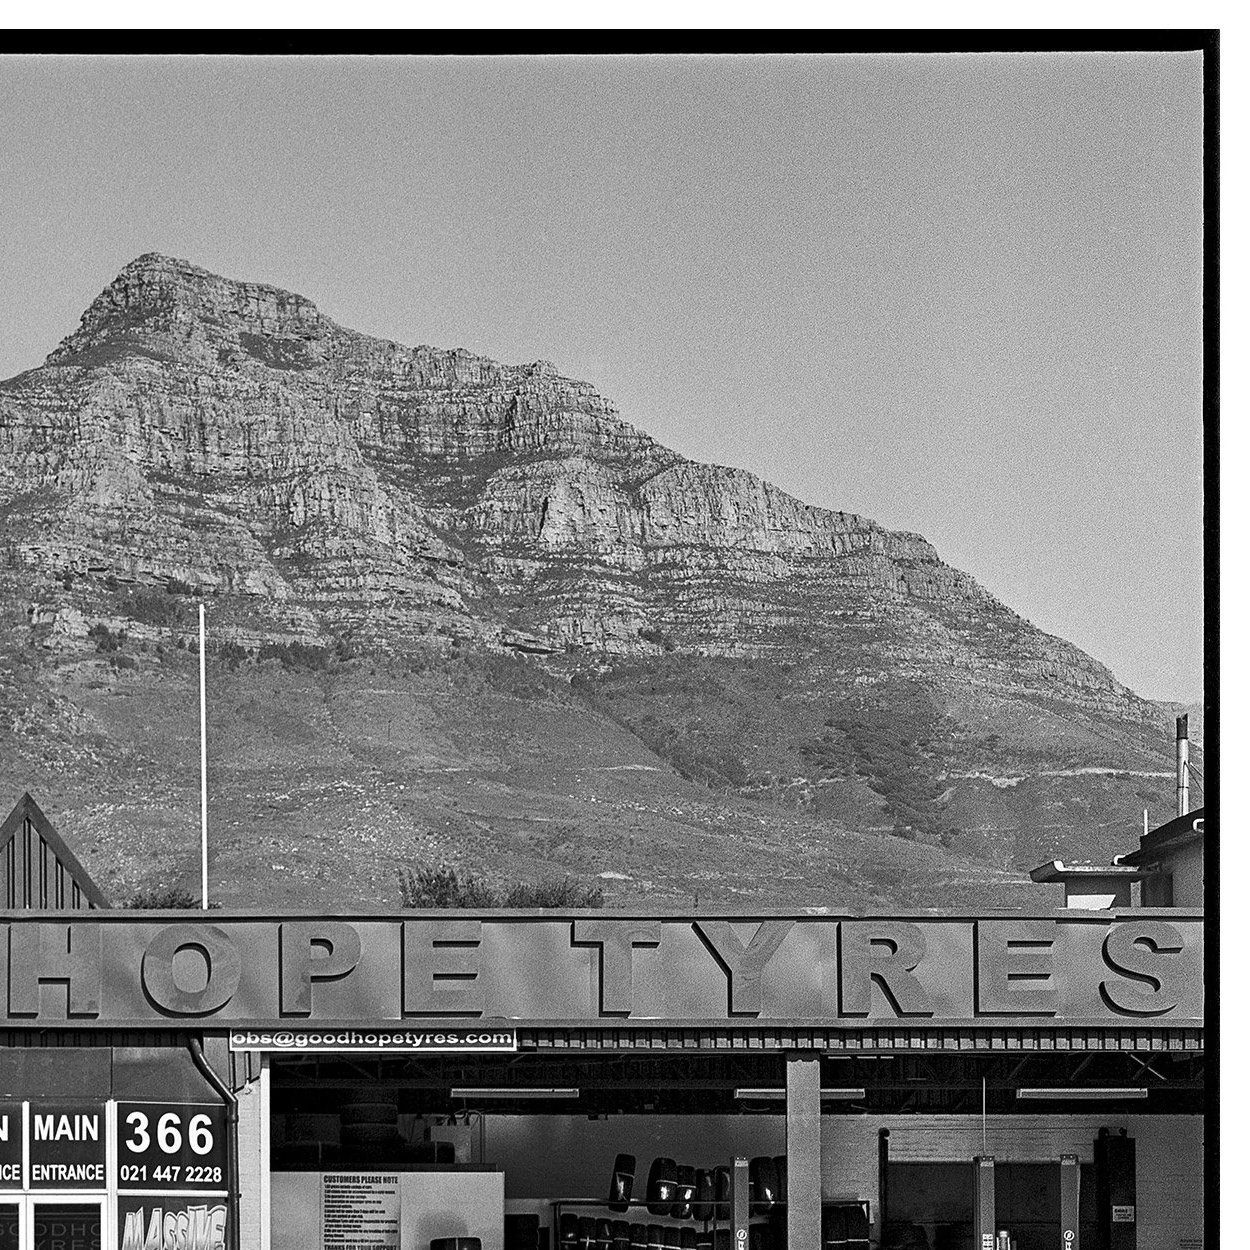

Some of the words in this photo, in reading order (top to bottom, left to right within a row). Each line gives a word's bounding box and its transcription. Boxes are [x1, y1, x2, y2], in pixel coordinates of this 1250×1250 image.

[569, 919, 1186, 1018] TYRES
[231, 1031, 513, 1048] obs@goodhopetyres.com
[34, 1114, 99, 1141] MAIN
[125, 1111, 214, 1155] 366
[32, 1164, 104, 1181] ENTRANCE
[120, 1165, 147, 1181] 021
[152, 1165, 181, 1182] 447
[185, 1166, 222, 1183] 2228
[323, 1175, 360, 1184] CUSTOMERS
[361, 1175, 382, 1184] PLEASE
[382, 1176, 399, 1184] NOTE
